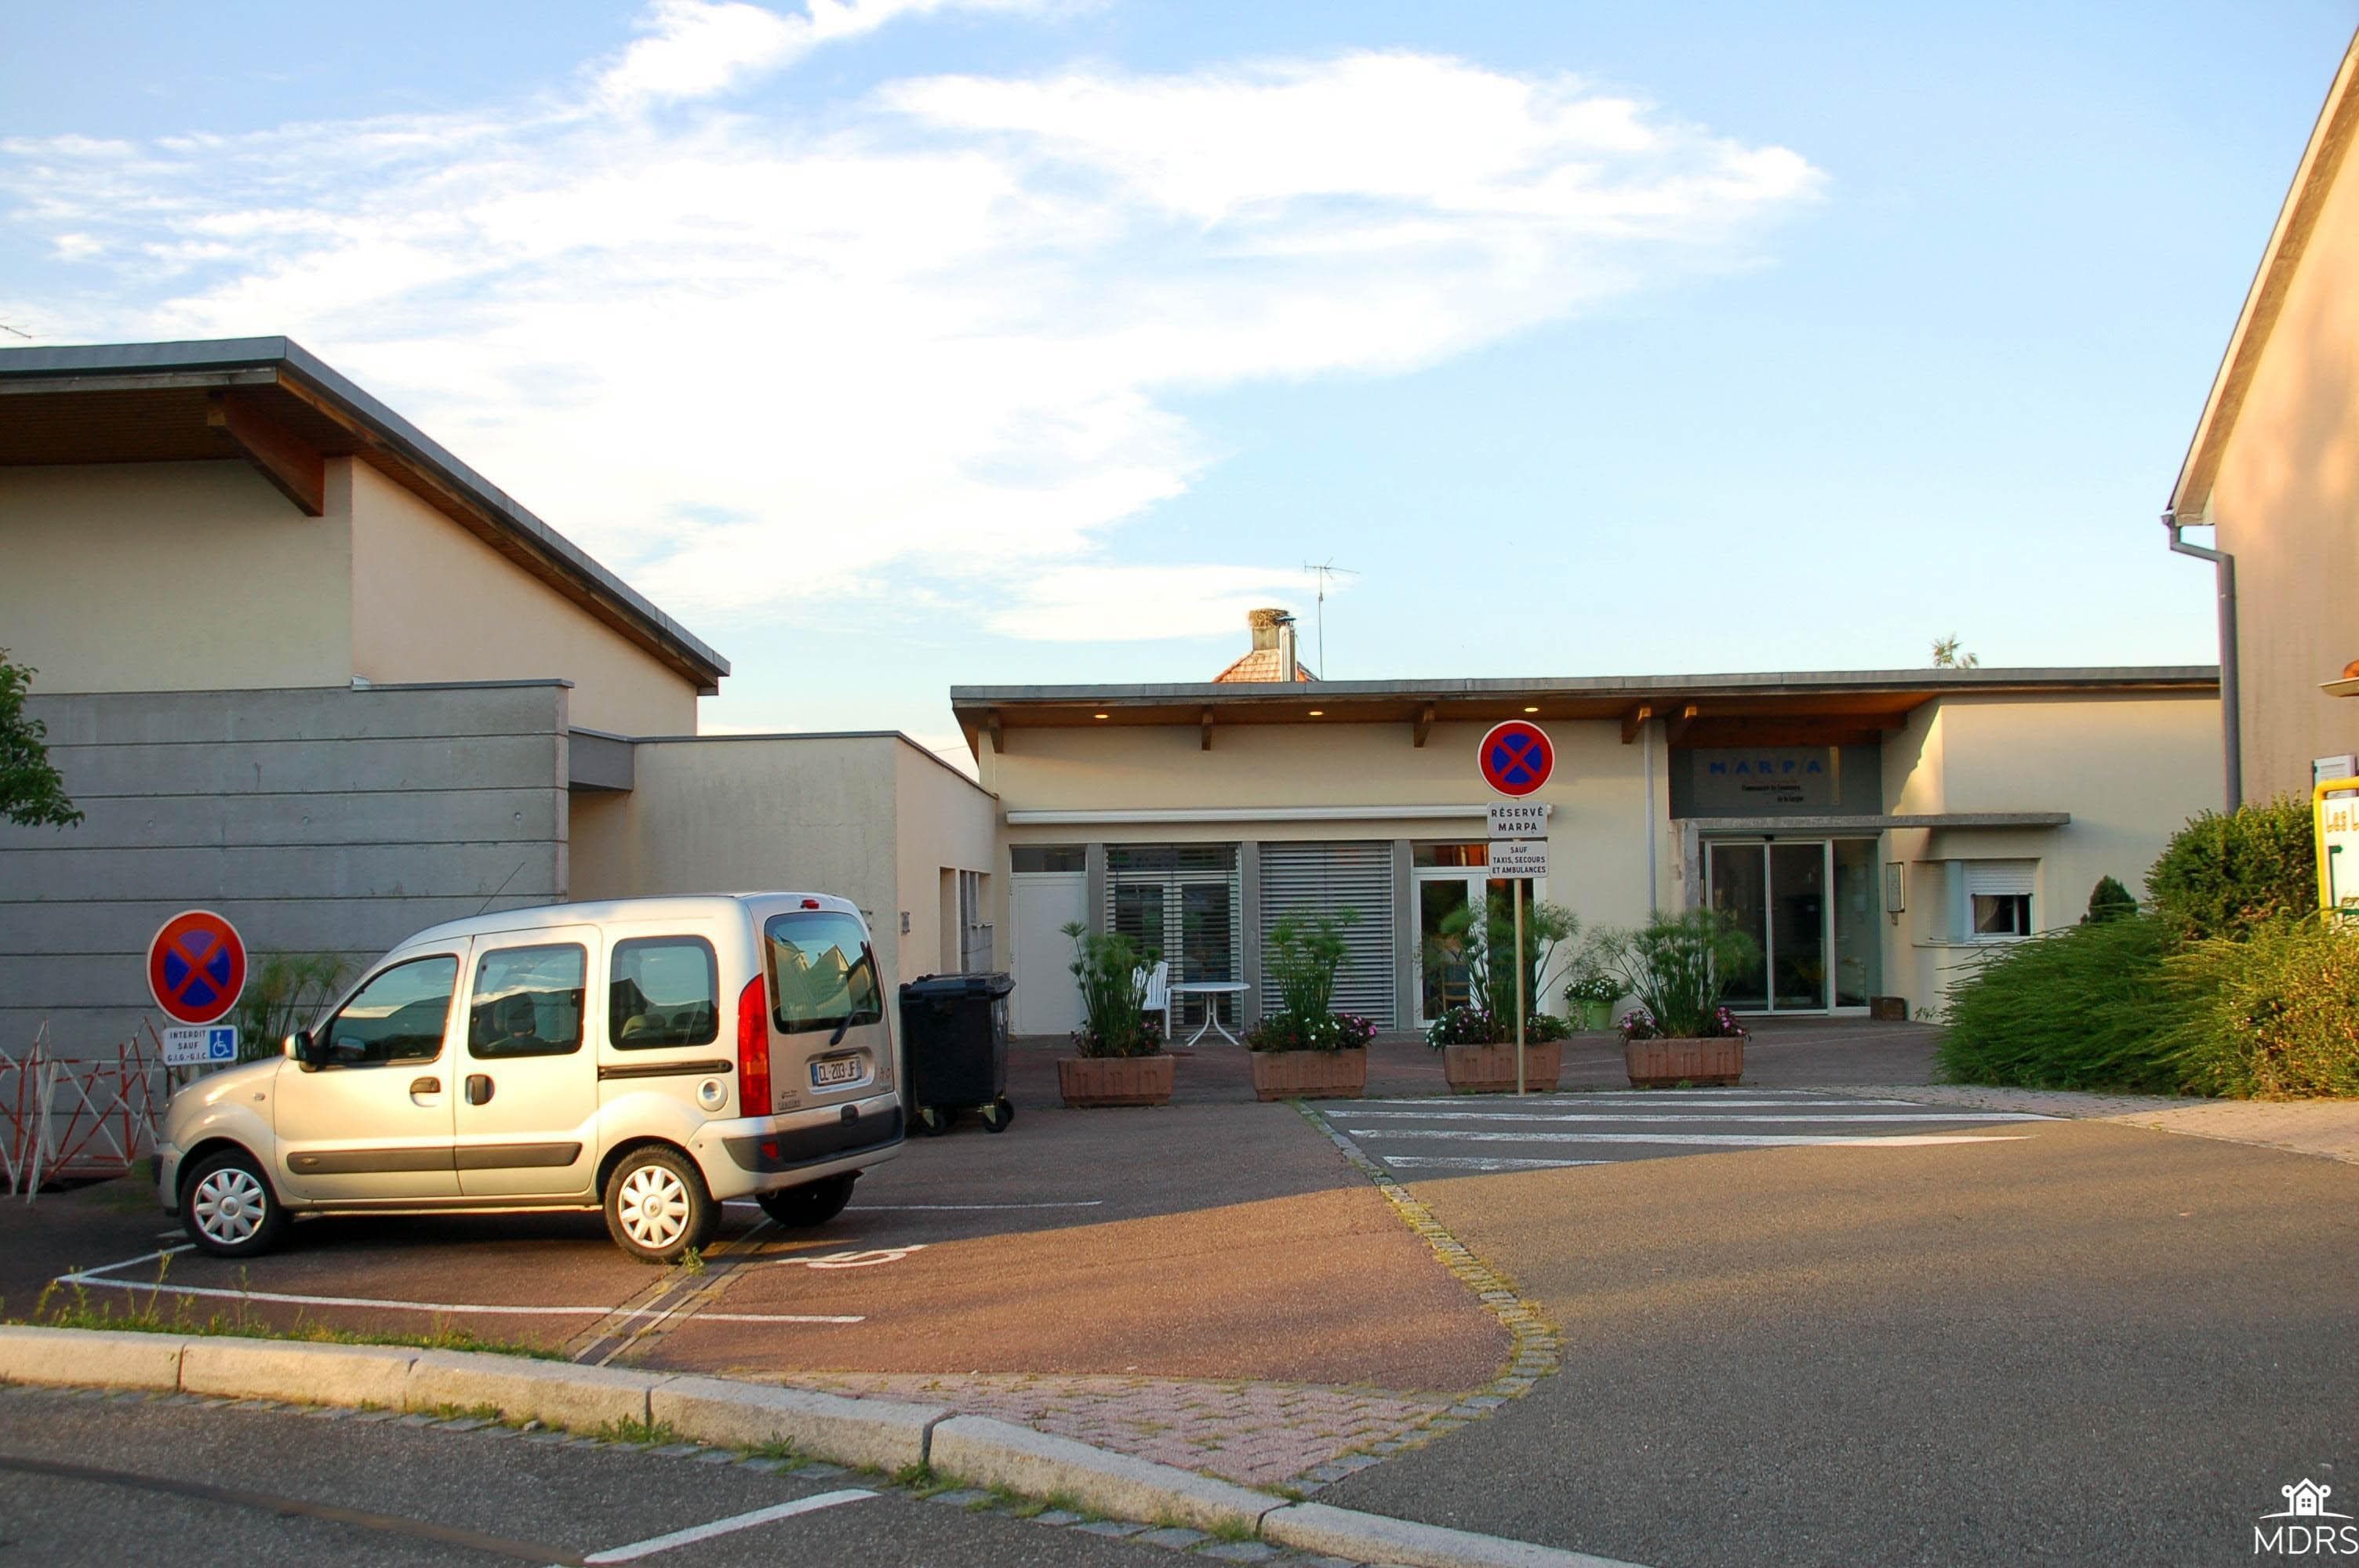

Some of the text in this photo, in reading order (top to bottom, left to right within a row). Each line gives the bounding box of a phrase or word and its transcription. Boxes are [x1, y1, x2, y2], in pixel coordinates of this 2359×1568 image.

[1492, 806, 1543, 817] RÉSERVÉ
[1499, 822, 1537, 831] MARPA
[170, 1030, 206, 1039] INTERDIT
